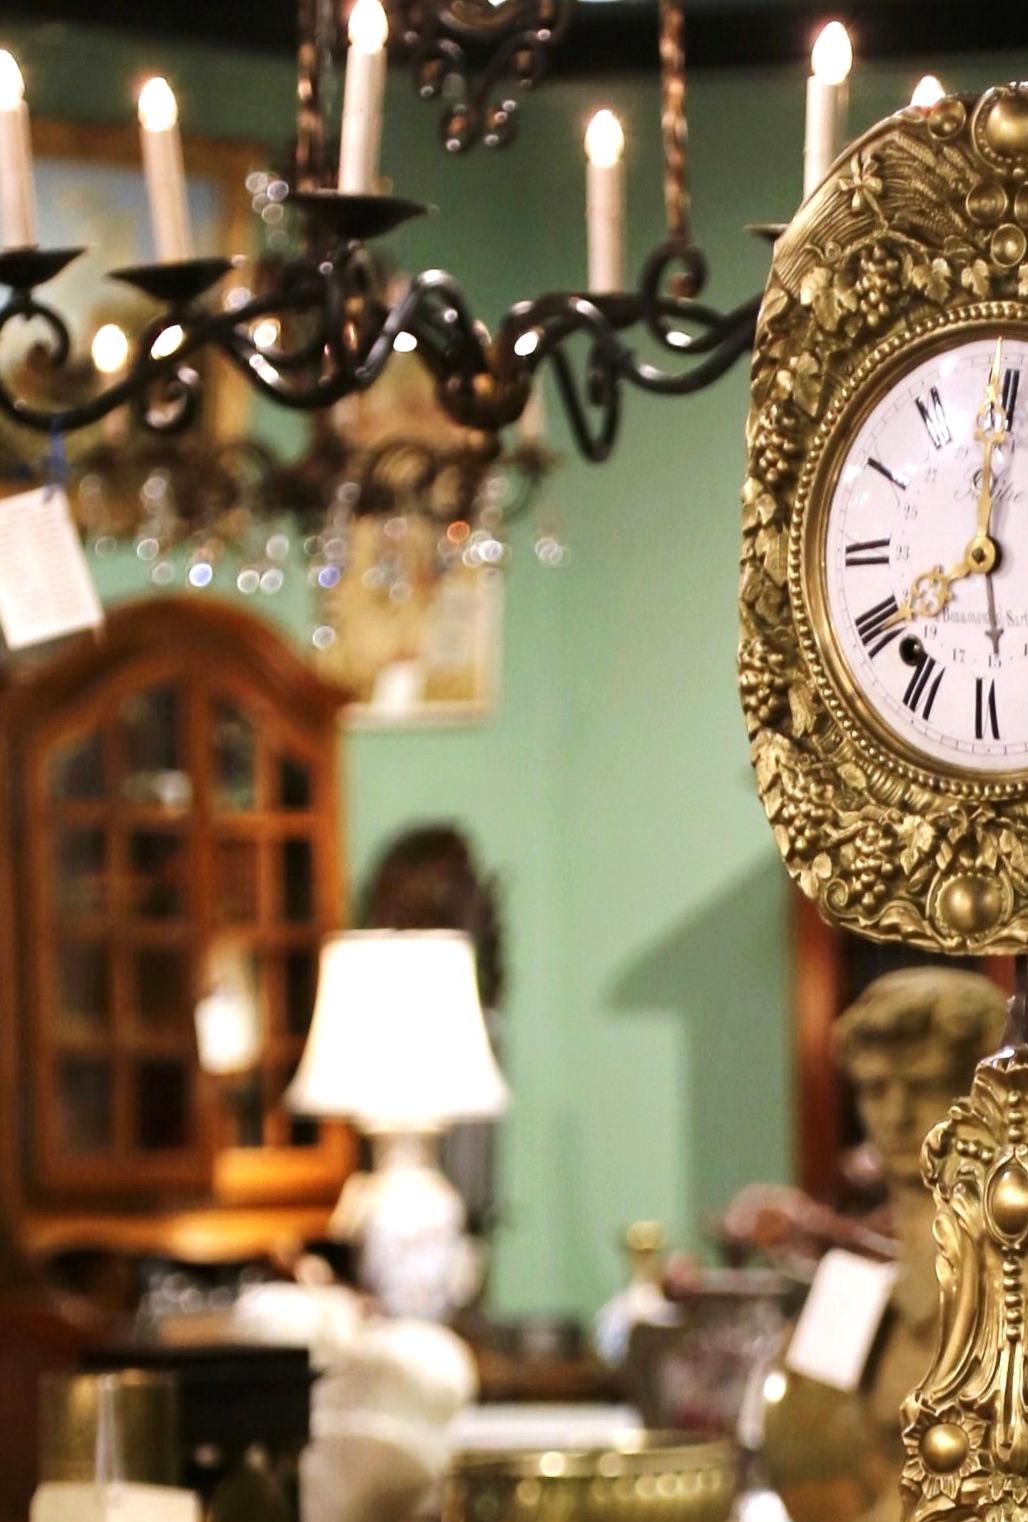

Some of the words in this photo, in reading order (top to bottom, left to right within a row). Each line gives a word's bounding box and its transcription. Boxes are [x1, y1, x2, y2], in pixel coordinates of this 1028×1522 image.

[924, 625, 937, 638] 19
[953, 647, 965, 662] 17
[975, 677, 1000, 740] VI
